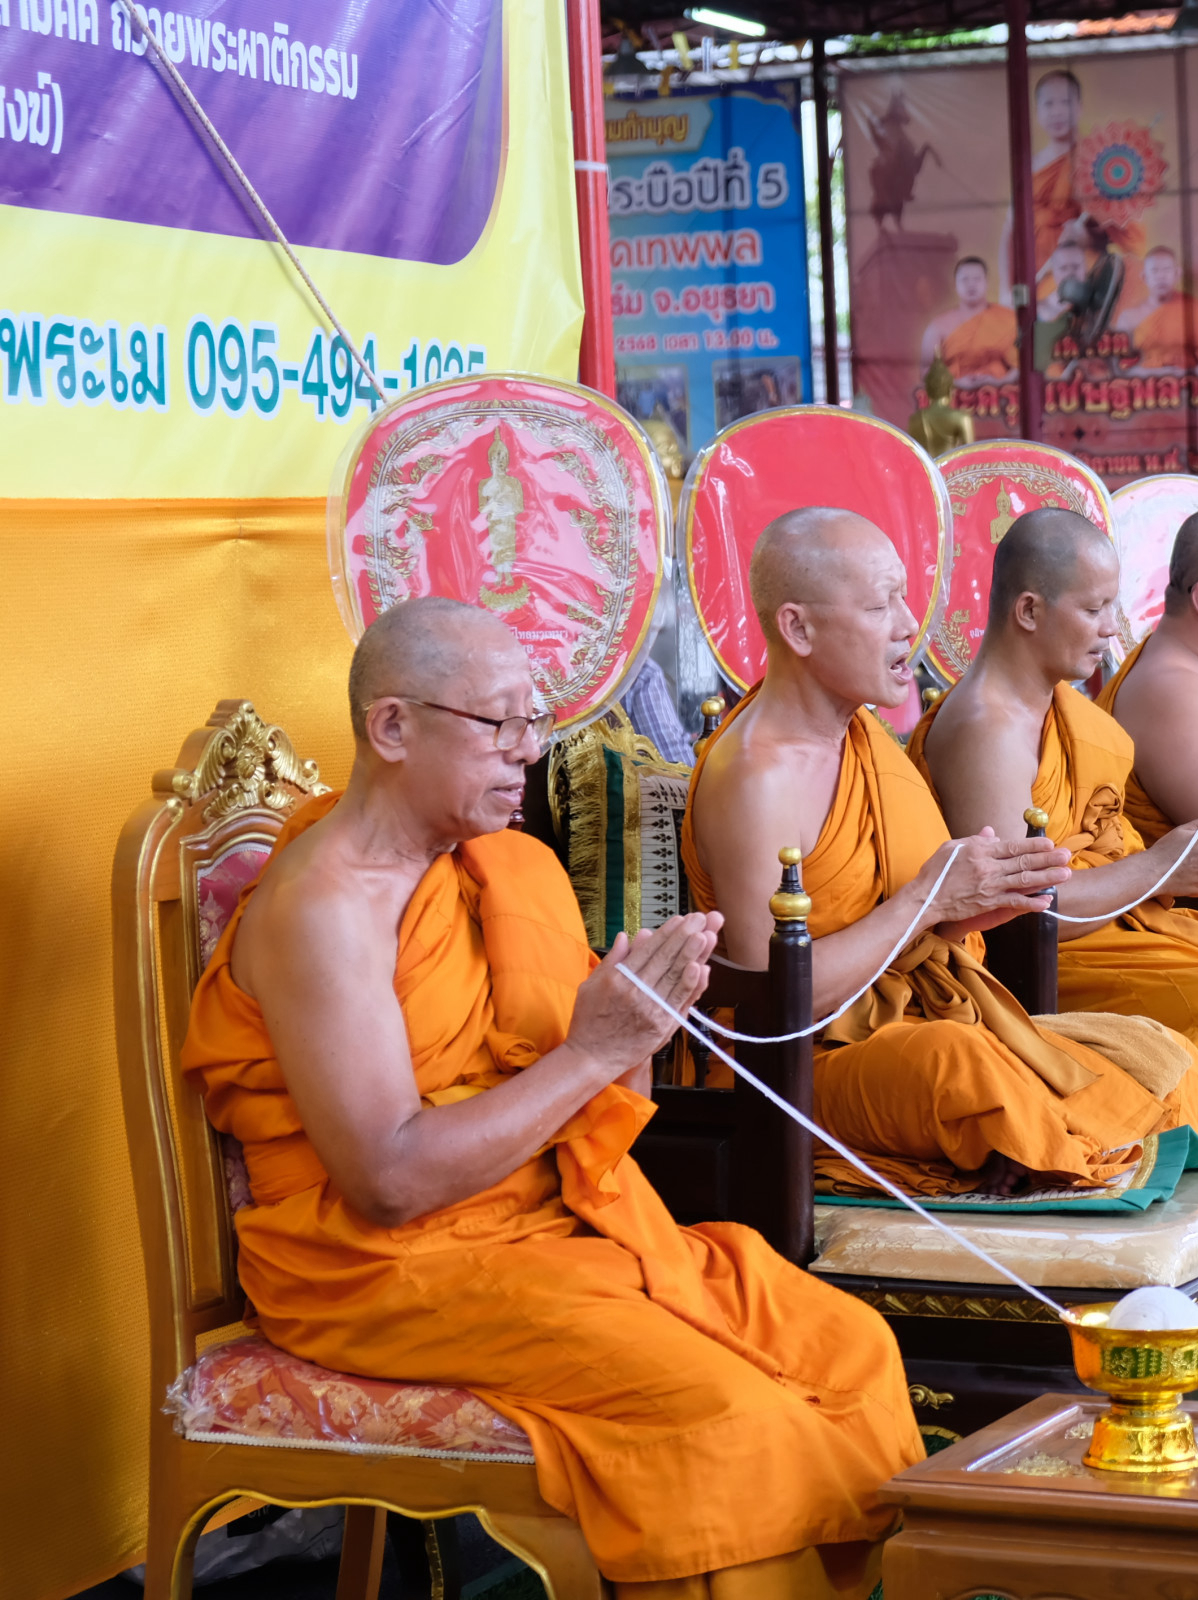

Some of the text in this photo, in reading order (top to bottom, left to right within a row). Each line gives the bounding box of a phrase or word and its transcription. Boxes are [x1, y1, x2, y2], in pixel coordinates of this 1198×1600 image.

[0, 0, 358, 100] ามคค ถวายพระผาติกรรม
[0, 71, 64, 155] งฆ์)
[606, 110, 689, 146] มทำบุญ
[759, 166, 786, 204] 5
[653, 283, 771, 321] จ.อยุธยา
